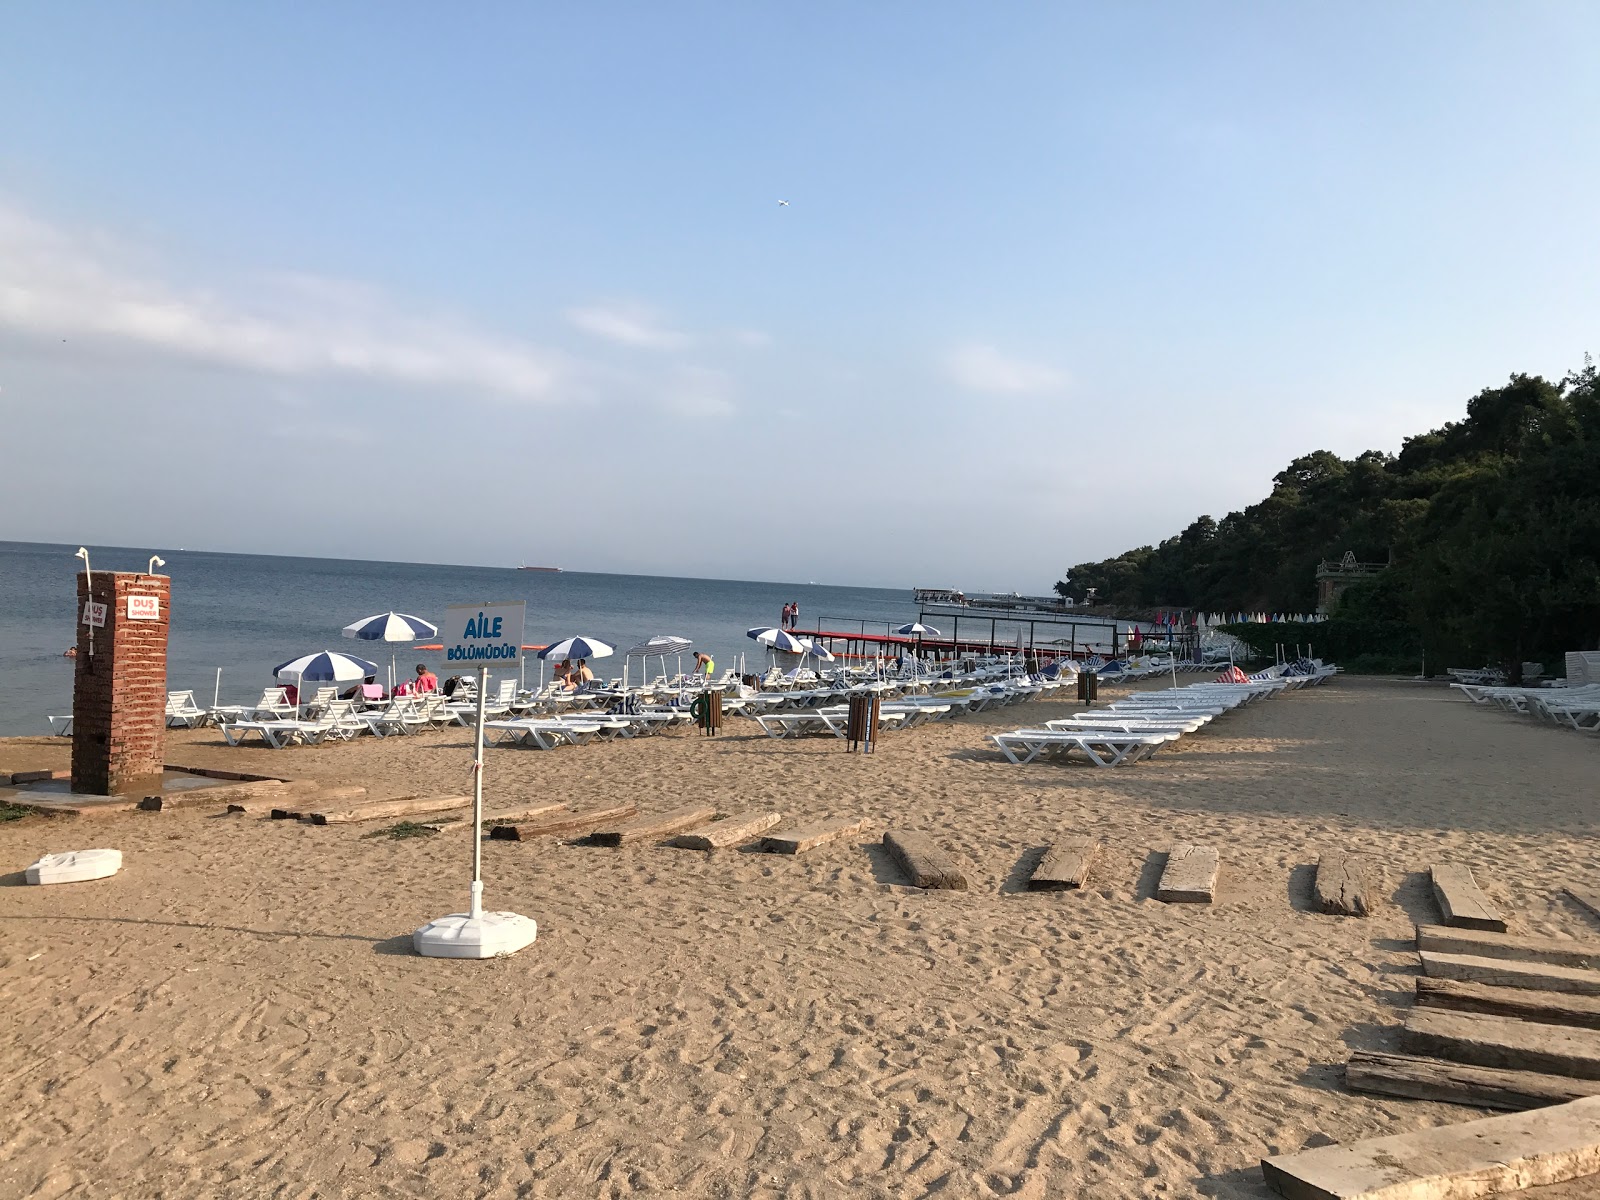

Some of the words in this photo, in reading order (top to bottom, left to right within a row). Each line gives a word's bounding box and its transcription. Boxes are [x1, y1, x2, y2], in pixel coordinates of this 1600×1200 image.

[133, 599, 154, 609] DUŞ
[463, 612, 503, 639] AİLE
[447, 643, 517, 660] BÖLÜMÜDÜR
